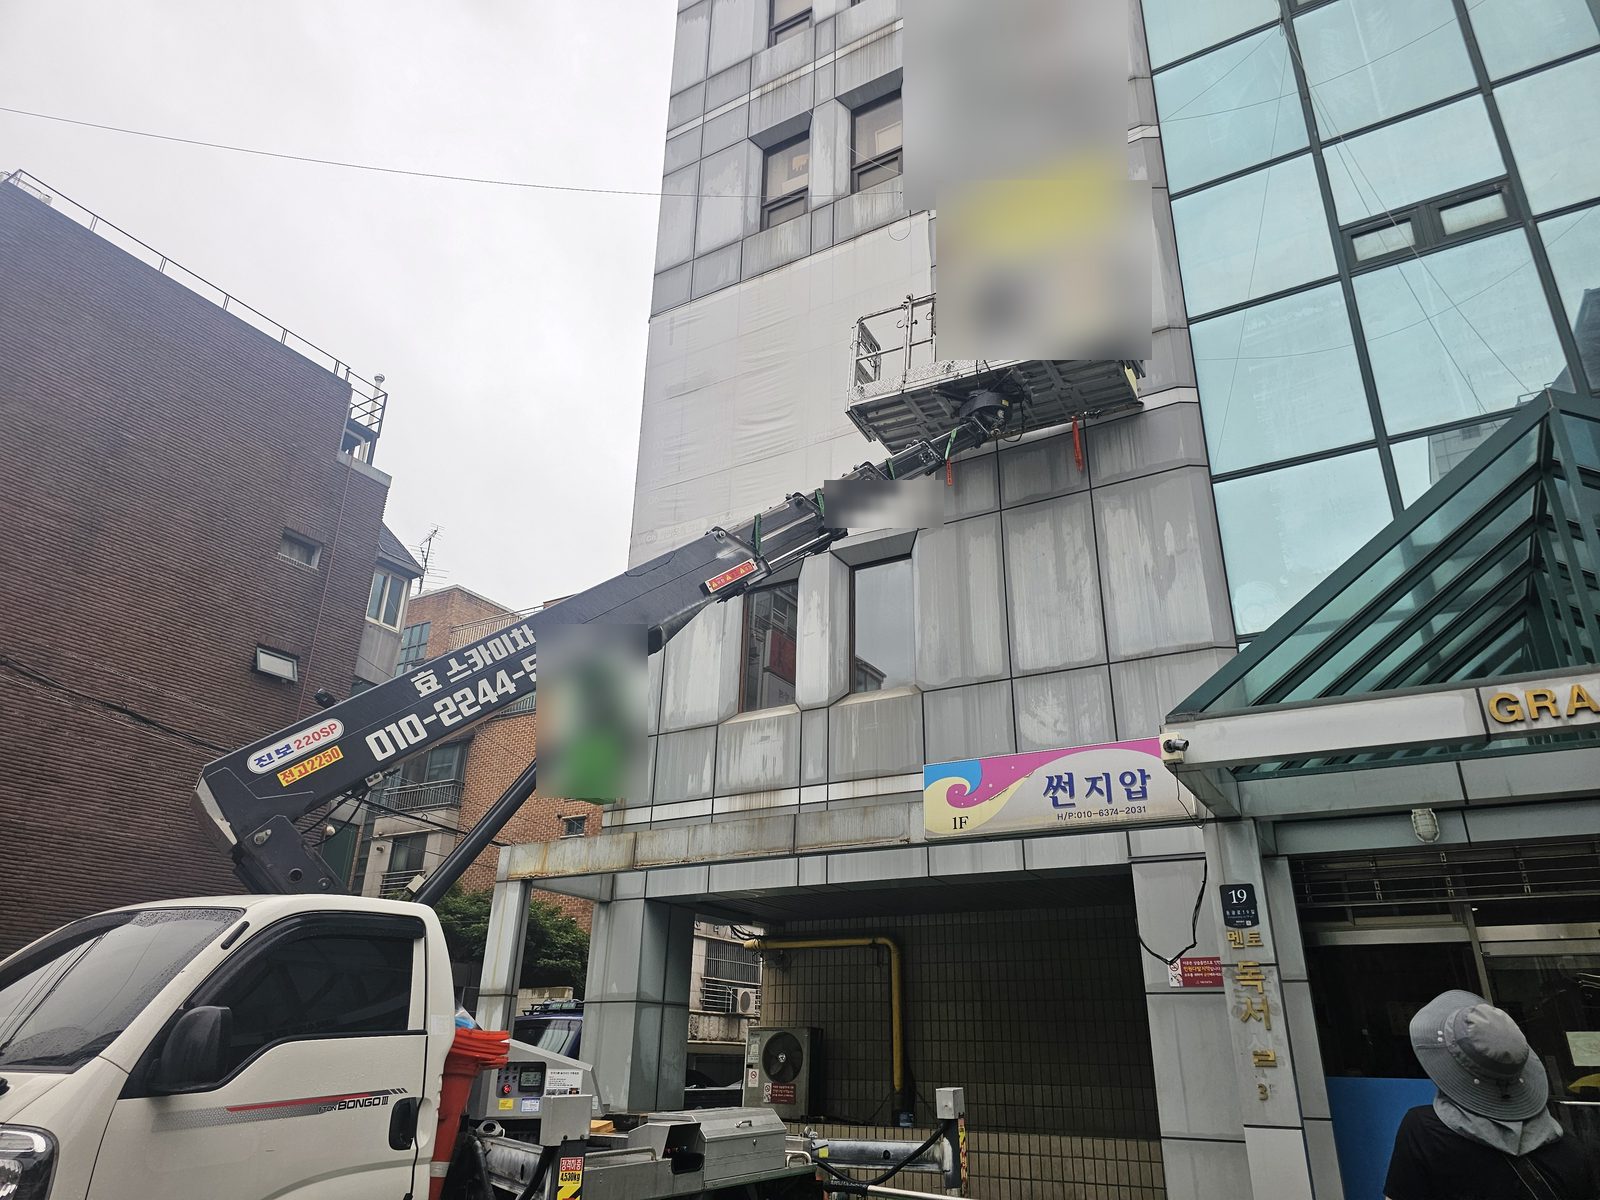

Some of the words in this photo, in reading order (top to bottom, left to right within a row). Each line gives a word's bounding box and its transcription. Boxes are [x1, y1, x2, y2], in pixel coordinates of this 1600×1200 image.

[411, 669, 442, 698] 효
[447, 624, 537, 683] 스카이차
[1488, 683, 1600, 734] GRA
[254, 743, 294, 768] 진보
[293, 723, 337, 750] 220SP
[1043, 768, 1152, 809] 썬지압
[952, 815, 969, 830] 1F
[1228, 888, 1247, 904] 19
[1226, 929, 1264, 949] 멘토
